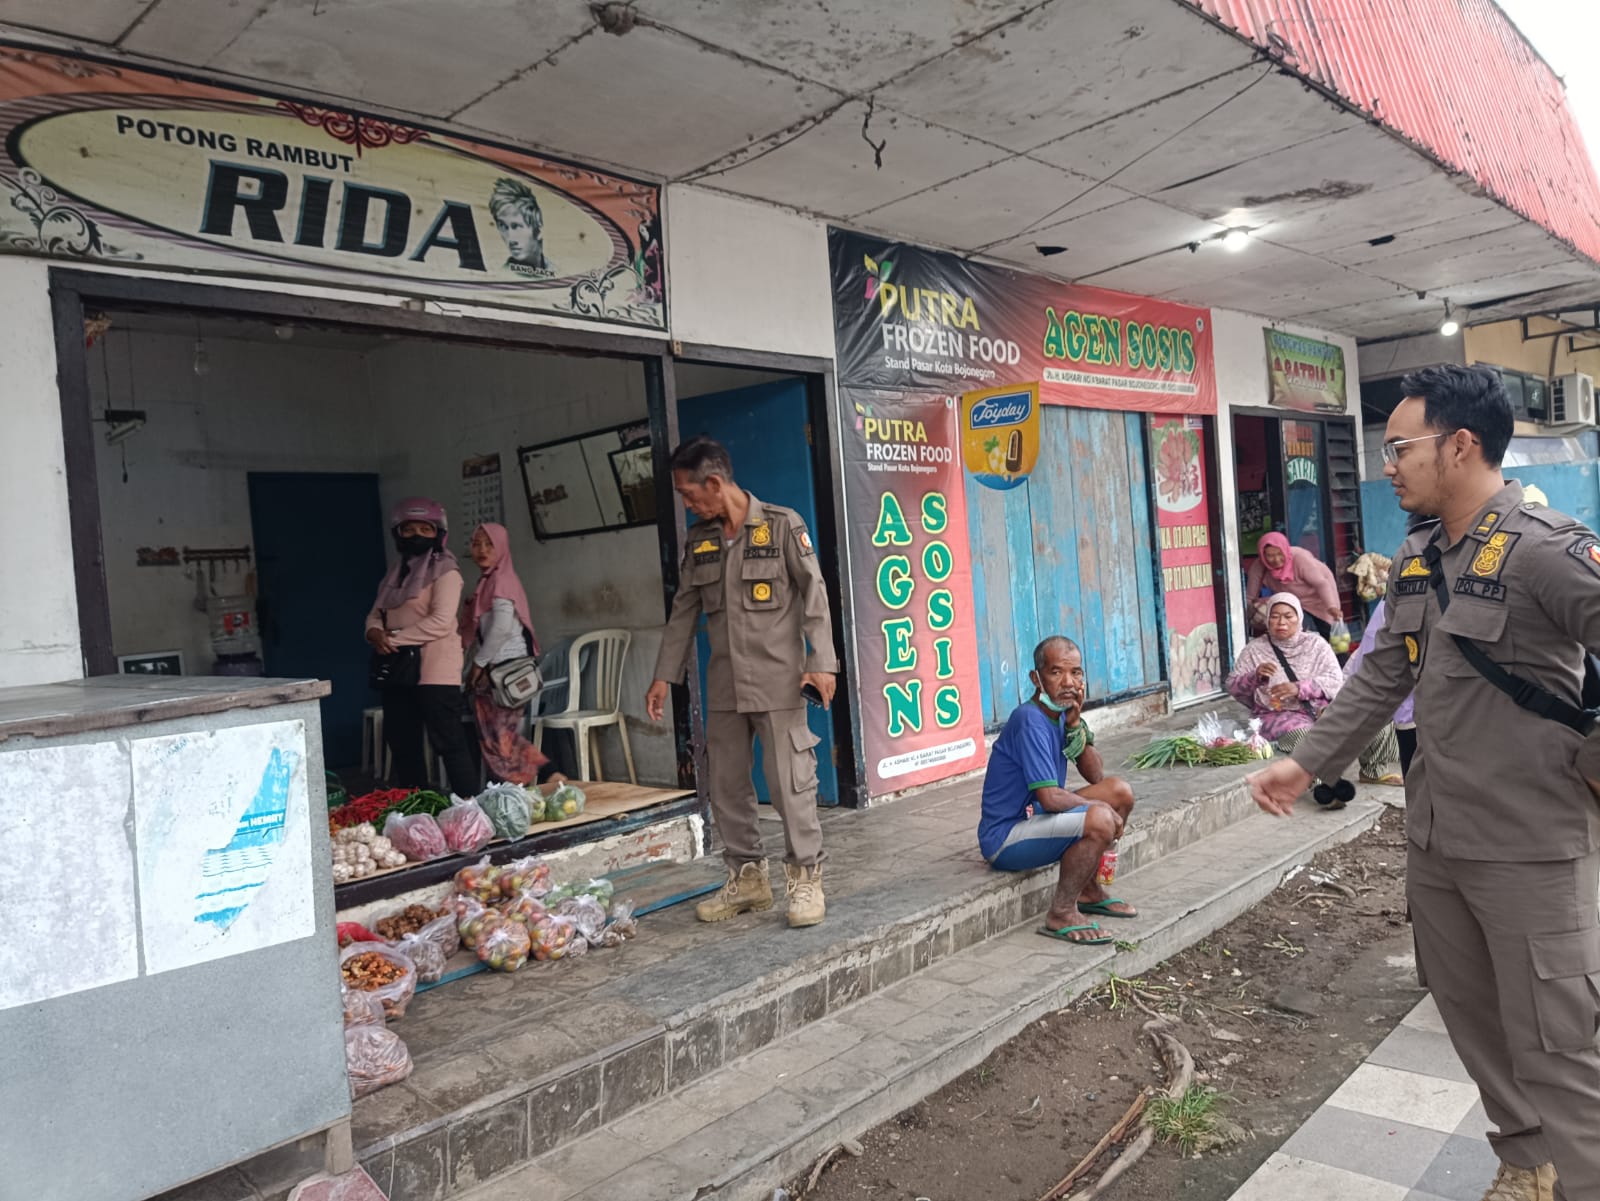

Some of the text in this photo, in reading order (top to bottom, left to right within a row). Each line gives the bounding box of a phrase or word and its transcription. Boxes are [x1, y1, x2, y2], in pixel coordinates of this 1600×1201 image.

[116, 114, 354, 173] POTONG RAMBUT
[200, 159, 487, 272] RIDA
[879, 282, 981, 332] PUTRA
[881, 323, 1021, 366] FROZEN FOOD
[1043, 306, 1196, 375] AGEN SOSIS
[884, 355, 996, 381] Stand Pasar Kota Bojonegoro
[864, 417, 929, 443] PUTRA
[974, 401, 1026, 424] Joyday
[866, 442, 953, 463] FROZEN FOOD
[867, 462, 883, 472] Stand
[1456, 579, 1500, 597] POL PP
[872, 491, 923, 738] AGEN
[920, 491, 962, 729] SOSIS
